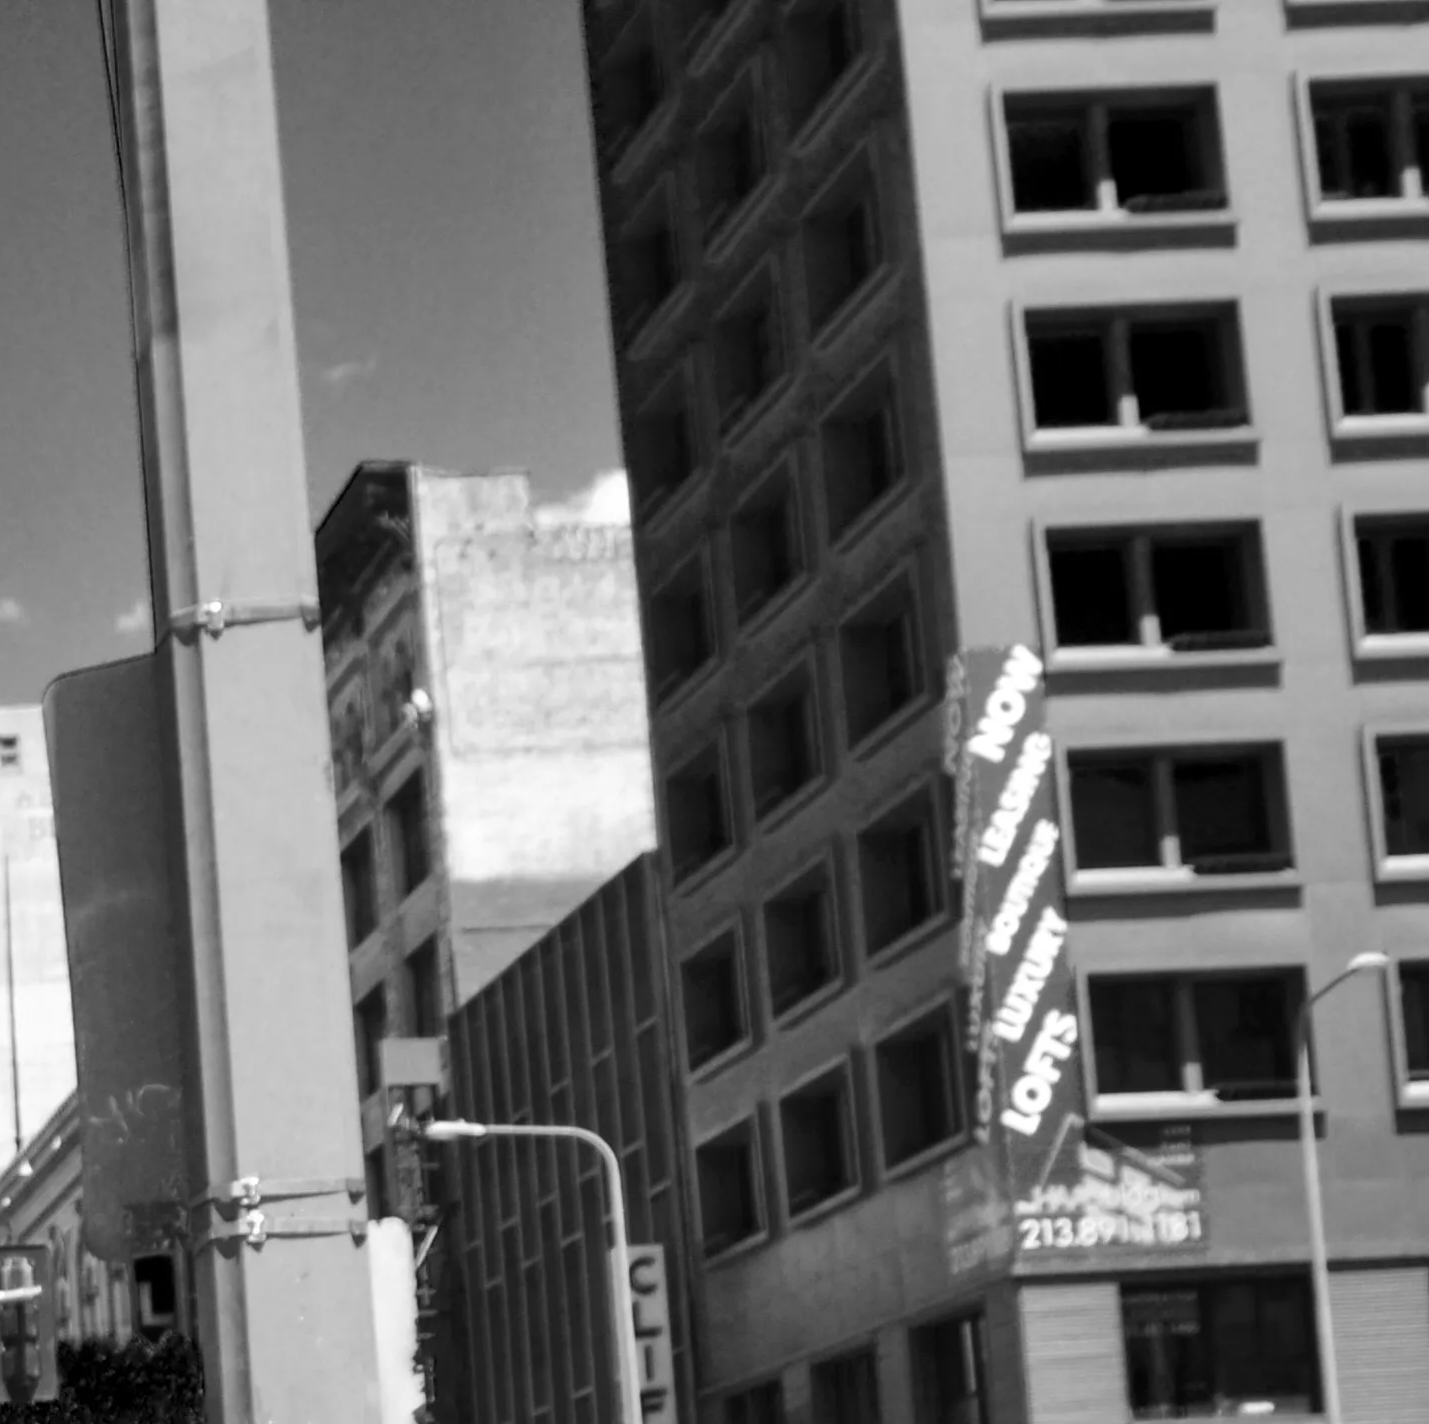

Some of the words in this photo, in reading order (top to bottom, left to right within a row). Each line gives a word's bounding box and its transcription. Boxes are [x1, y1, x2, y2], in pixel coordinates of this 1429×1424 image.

[967, 643, 1043, 762] NOW
[978, 731, 1052, 867] LEASING
[992, 905, 1068, 1043] LUXURY
[1000, 1008, 1078, 1135] LOFTS
